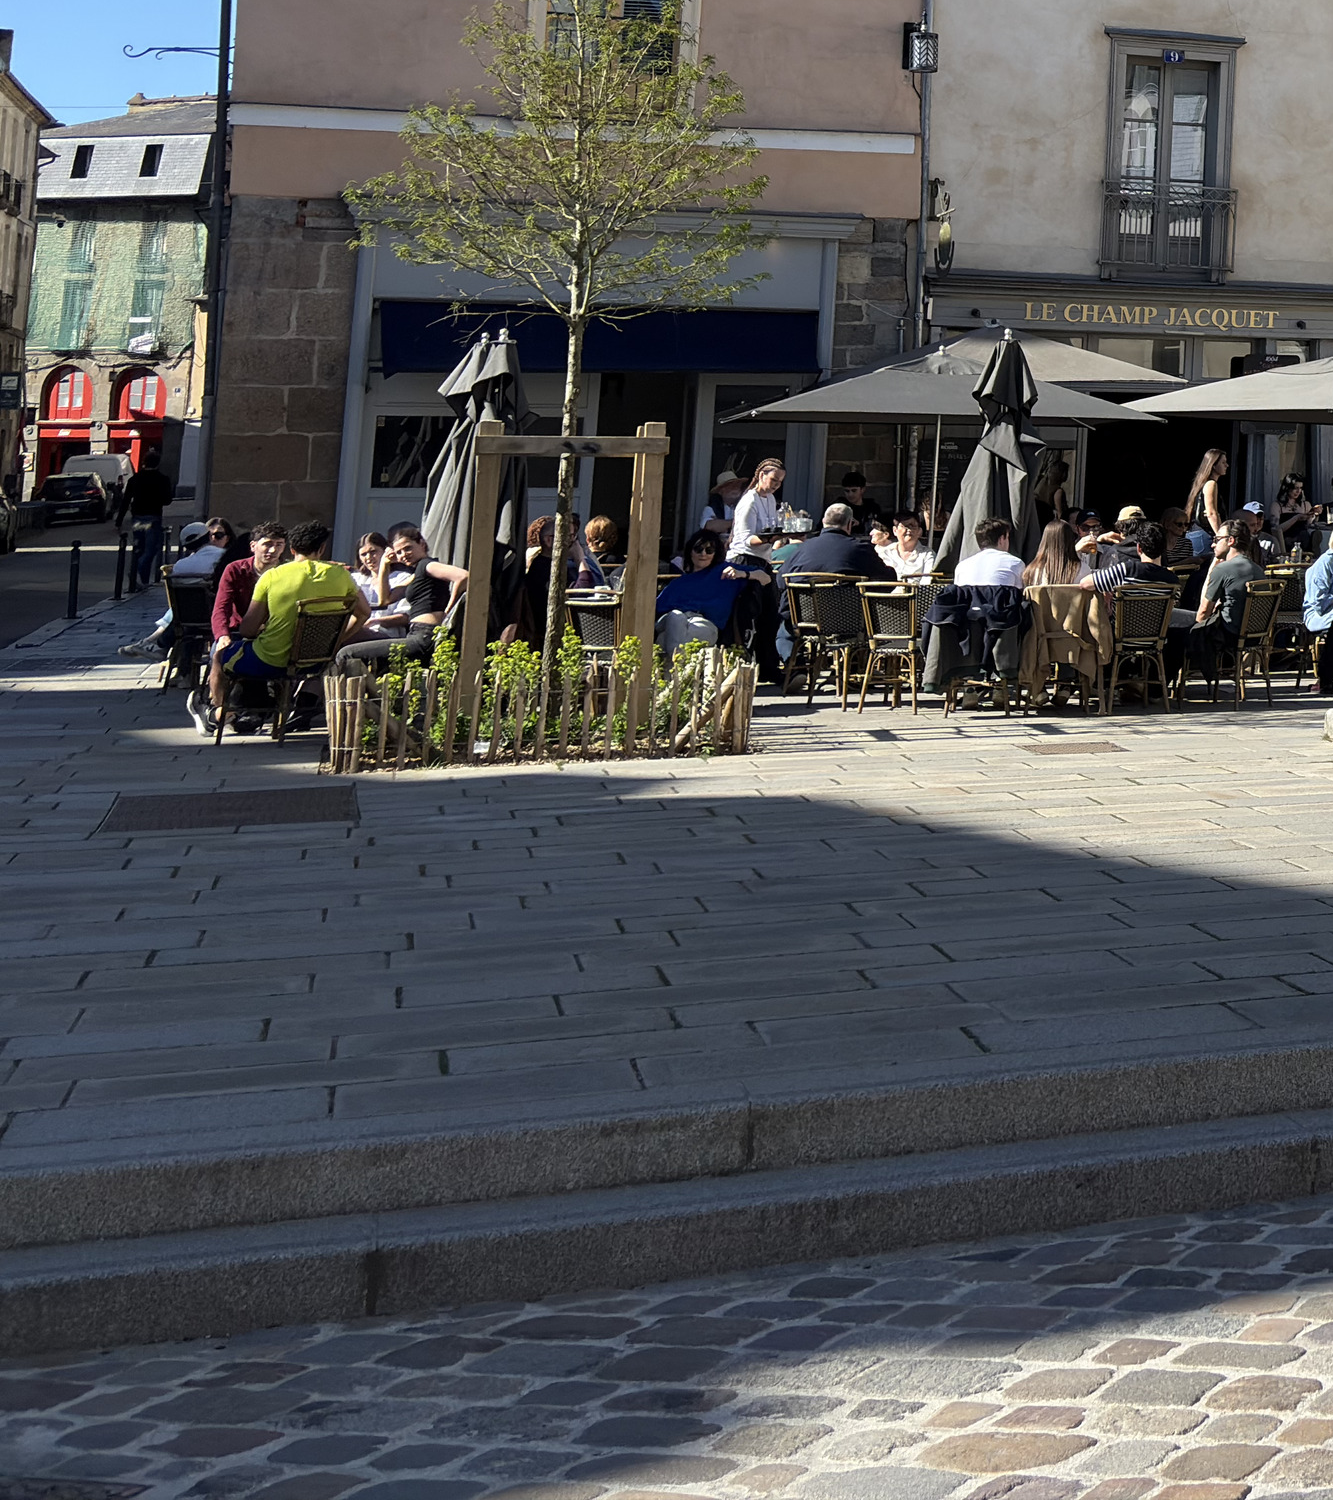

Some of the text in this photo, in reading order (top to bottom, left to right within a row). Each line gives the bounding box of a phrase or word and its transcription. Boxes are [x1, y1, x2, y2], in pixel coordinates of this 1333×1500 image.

[1023, 301, 1280, 331] LE CHAMP JACQUET
